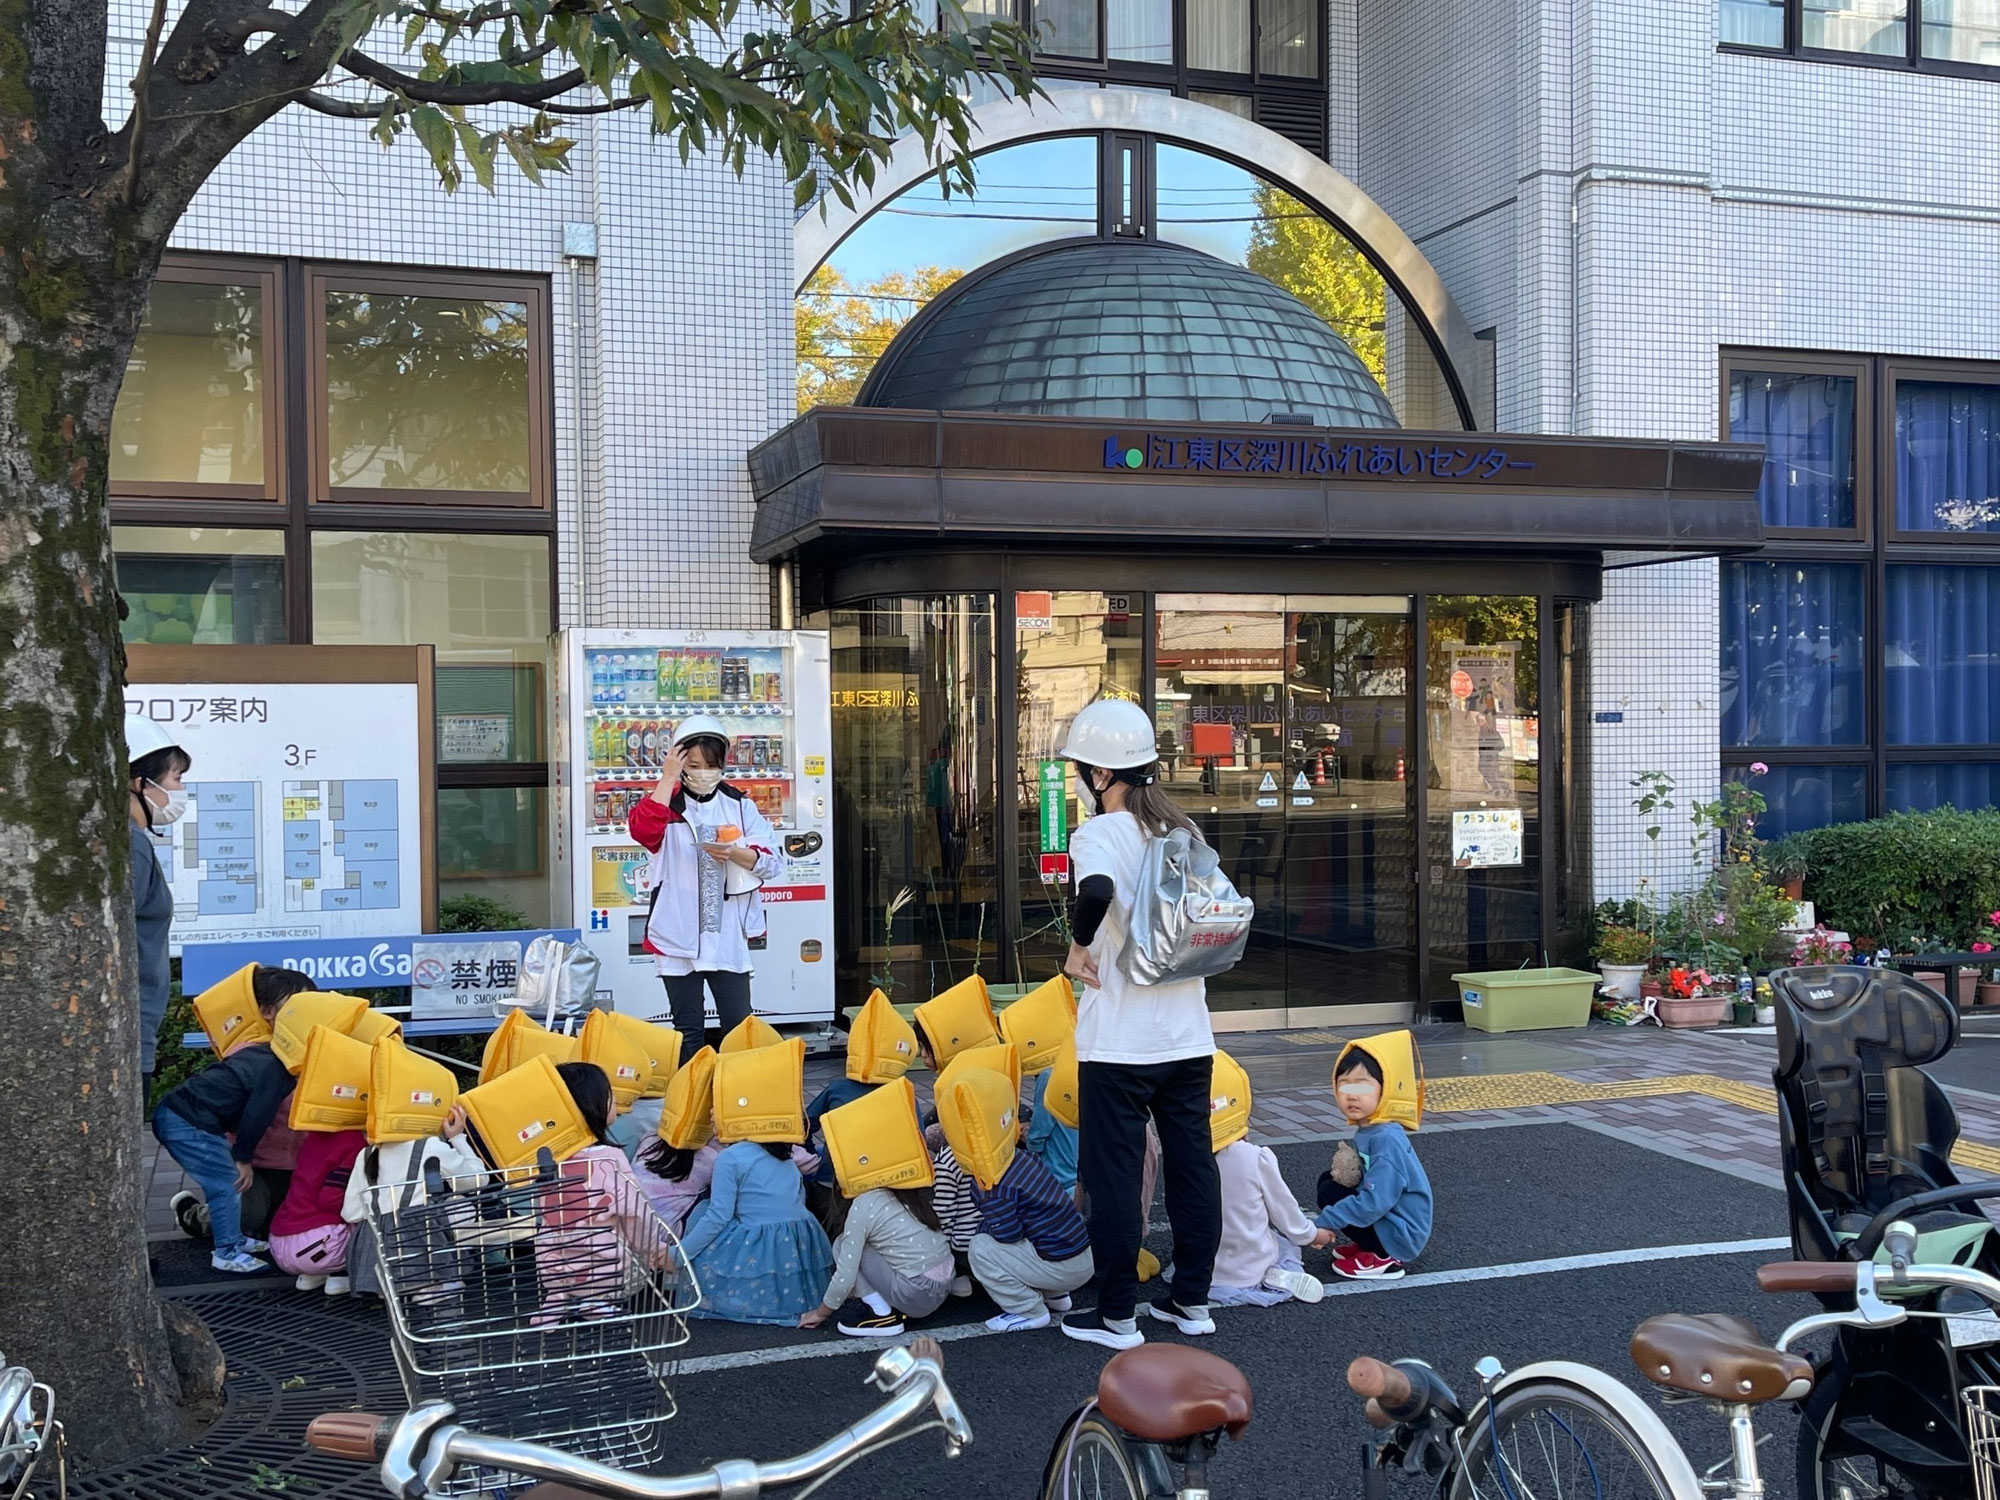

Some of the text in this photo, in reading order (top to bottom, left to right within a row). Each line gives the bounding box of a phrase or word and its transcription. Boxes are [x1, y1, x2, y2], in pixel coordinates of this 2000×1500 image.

[1153, 438, 1536, 478] 江東区深川ふれあいセンター
[1018, 618, 1049, 628] SECOM
[284, 744, 317, 766] 3F
[1190, 930, 1241, 948] 非常持出
[451, 958, 517, 989] 禁煙
[455, 994, 468, 1005] NO
